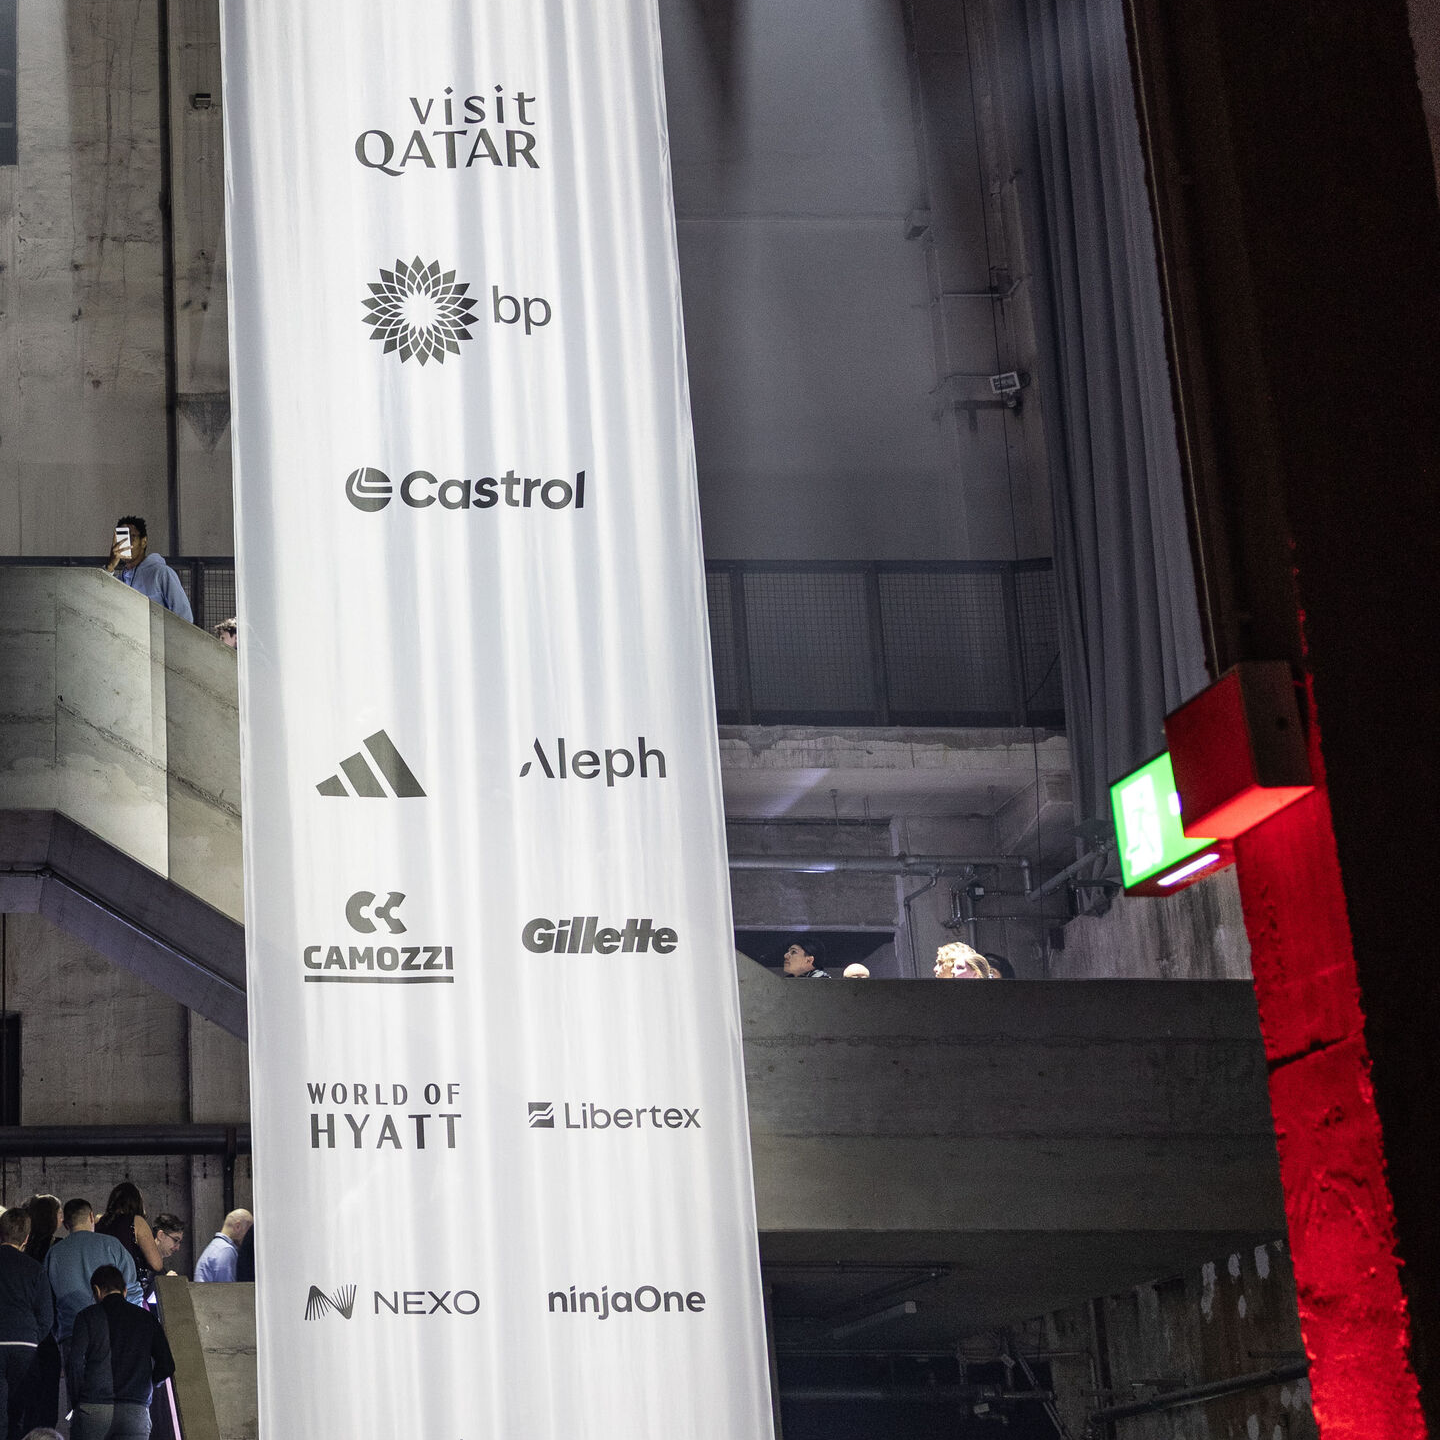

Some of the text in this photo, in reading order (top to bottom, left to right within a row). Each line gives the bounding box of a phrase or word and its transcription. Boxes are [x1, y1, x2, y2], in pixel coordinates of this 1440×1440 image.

[408, 83, 537, 126] visit
[354, 128, 541, 177] QATAR
[491, 284, 552, 336] bp
[399, 469, 586, 511] Castrol
[518, 736, 667, 788] Aleph
[521, 915, 679, 955] Gillette
[303, 945, 454, 972] CAMOZZI
[306, 1082, 462, 1106] WORLD OF
[310, 1112, 462, 1150] HYATT
[564, 1102, 702, 1130] Libertex
[373, 1289, 481, 1316] NEXO
[547, 1284, 707, 1321] ninjaOne
